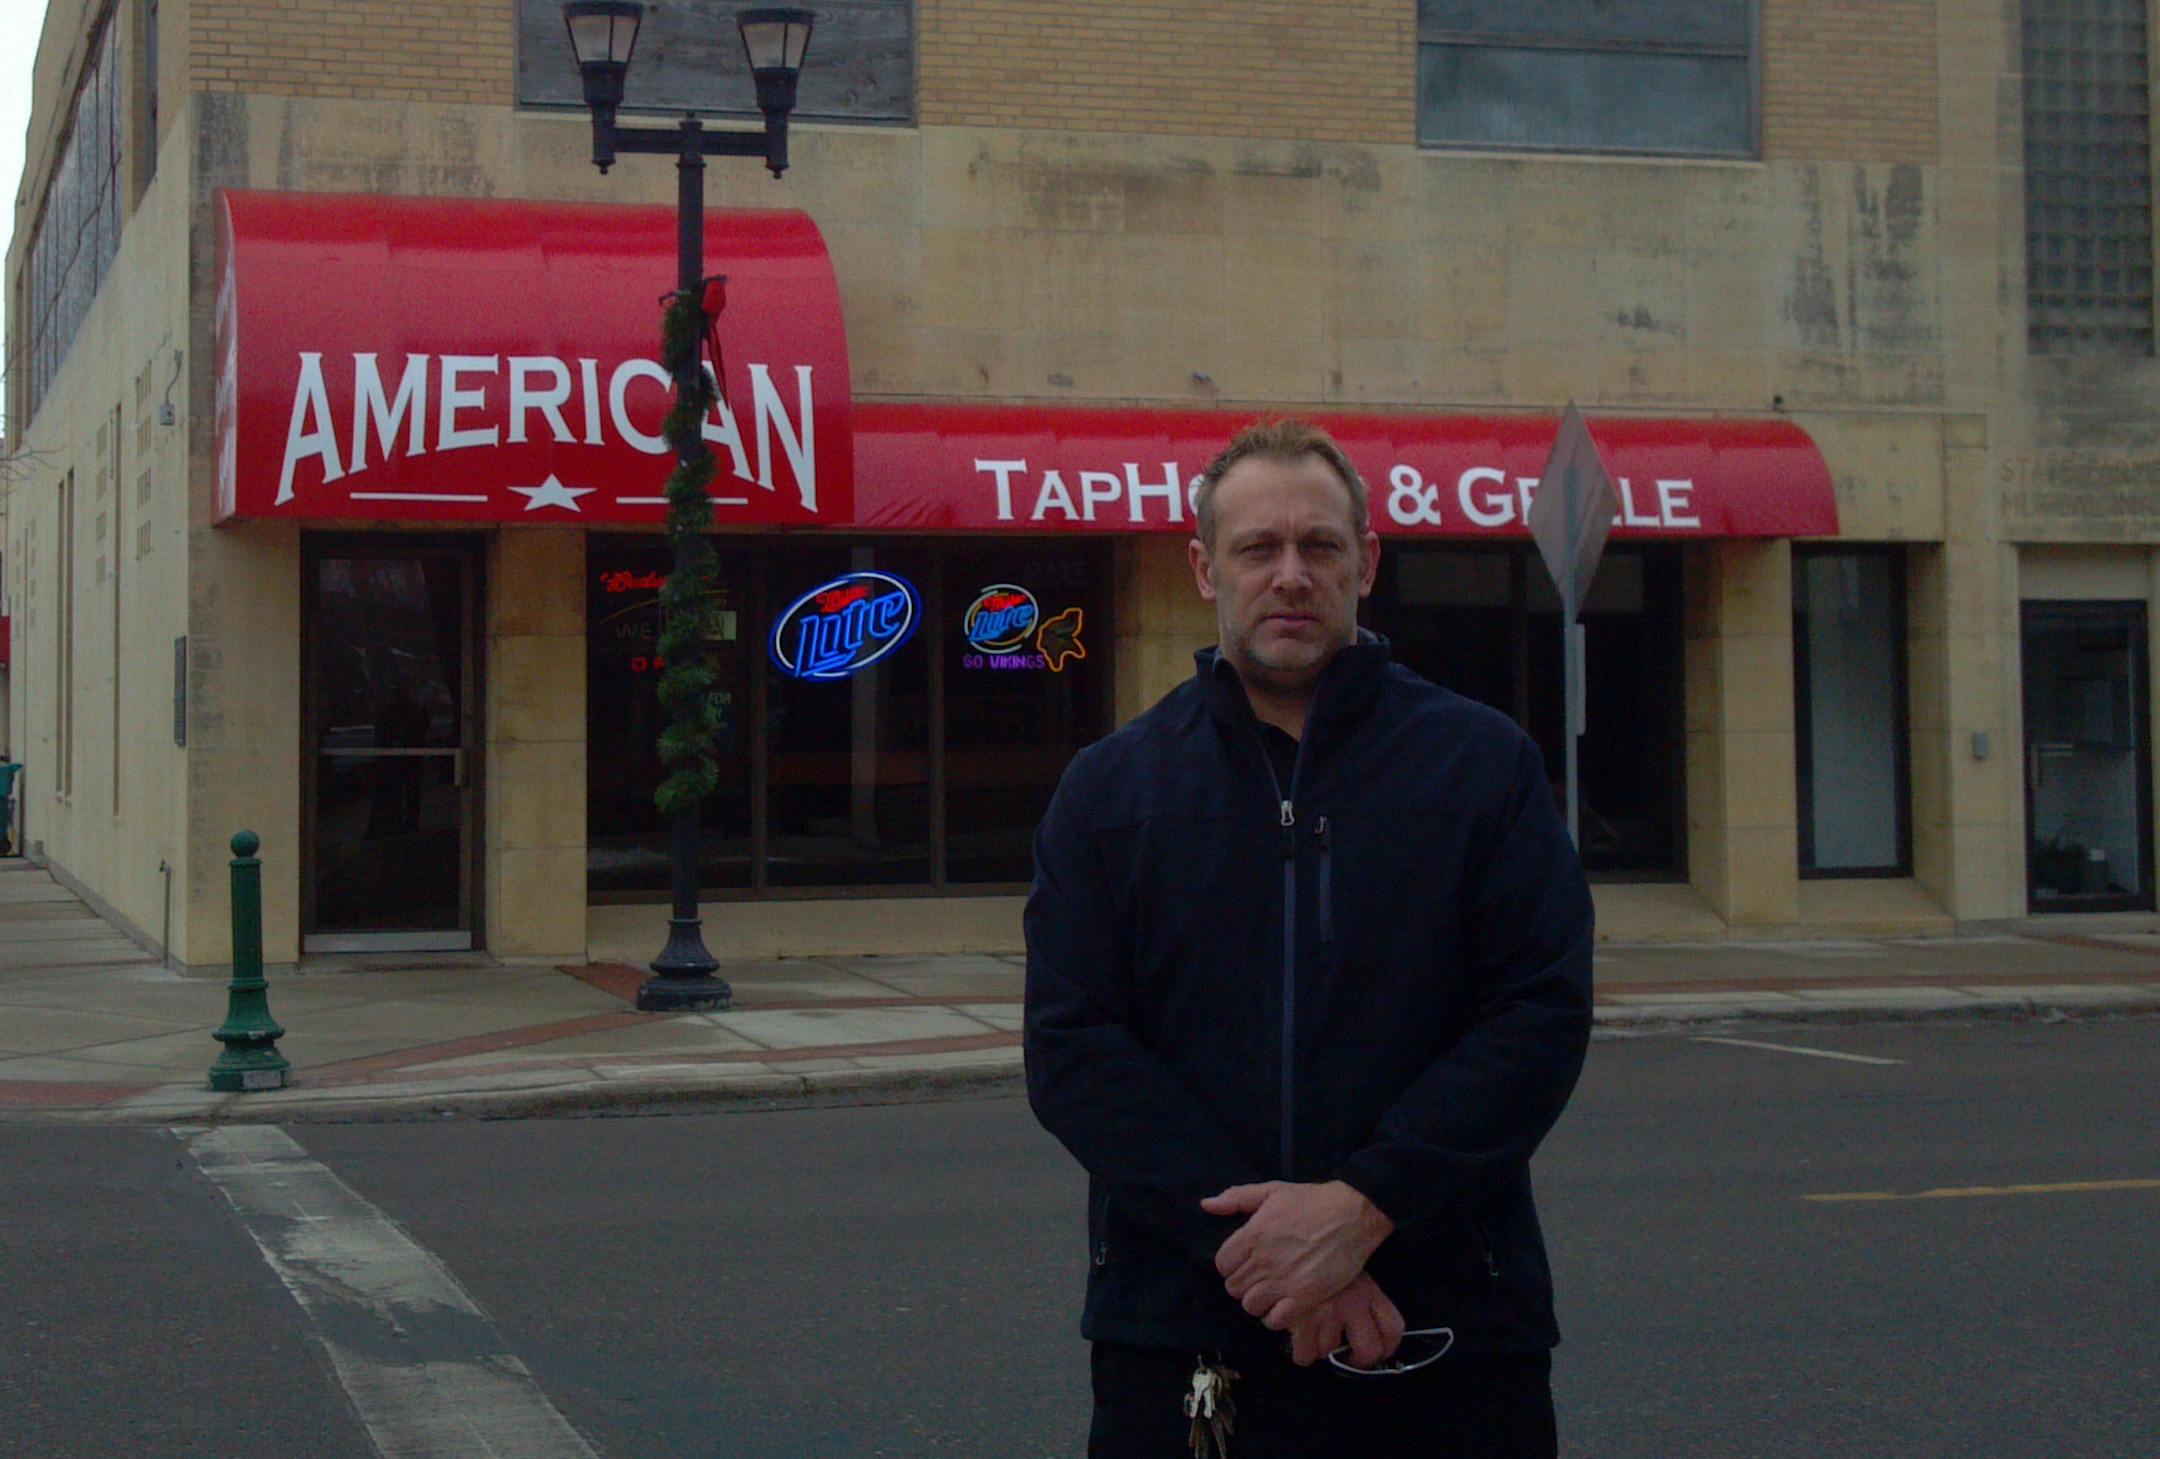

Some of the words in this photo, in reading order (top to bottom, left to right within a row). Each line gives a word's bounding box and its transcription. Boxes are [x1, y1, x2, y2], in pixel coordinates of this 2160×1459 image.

[274, 351, 818, 513] AMERICAN
[974, 457, 1369, 526] TAPH
[1387, 464, 1442, 527] &
[1457, 466, 1700, 528] GLE
[962, 654, 984, 670] GO
[989, 654, 1046, 670] VIKINGS
